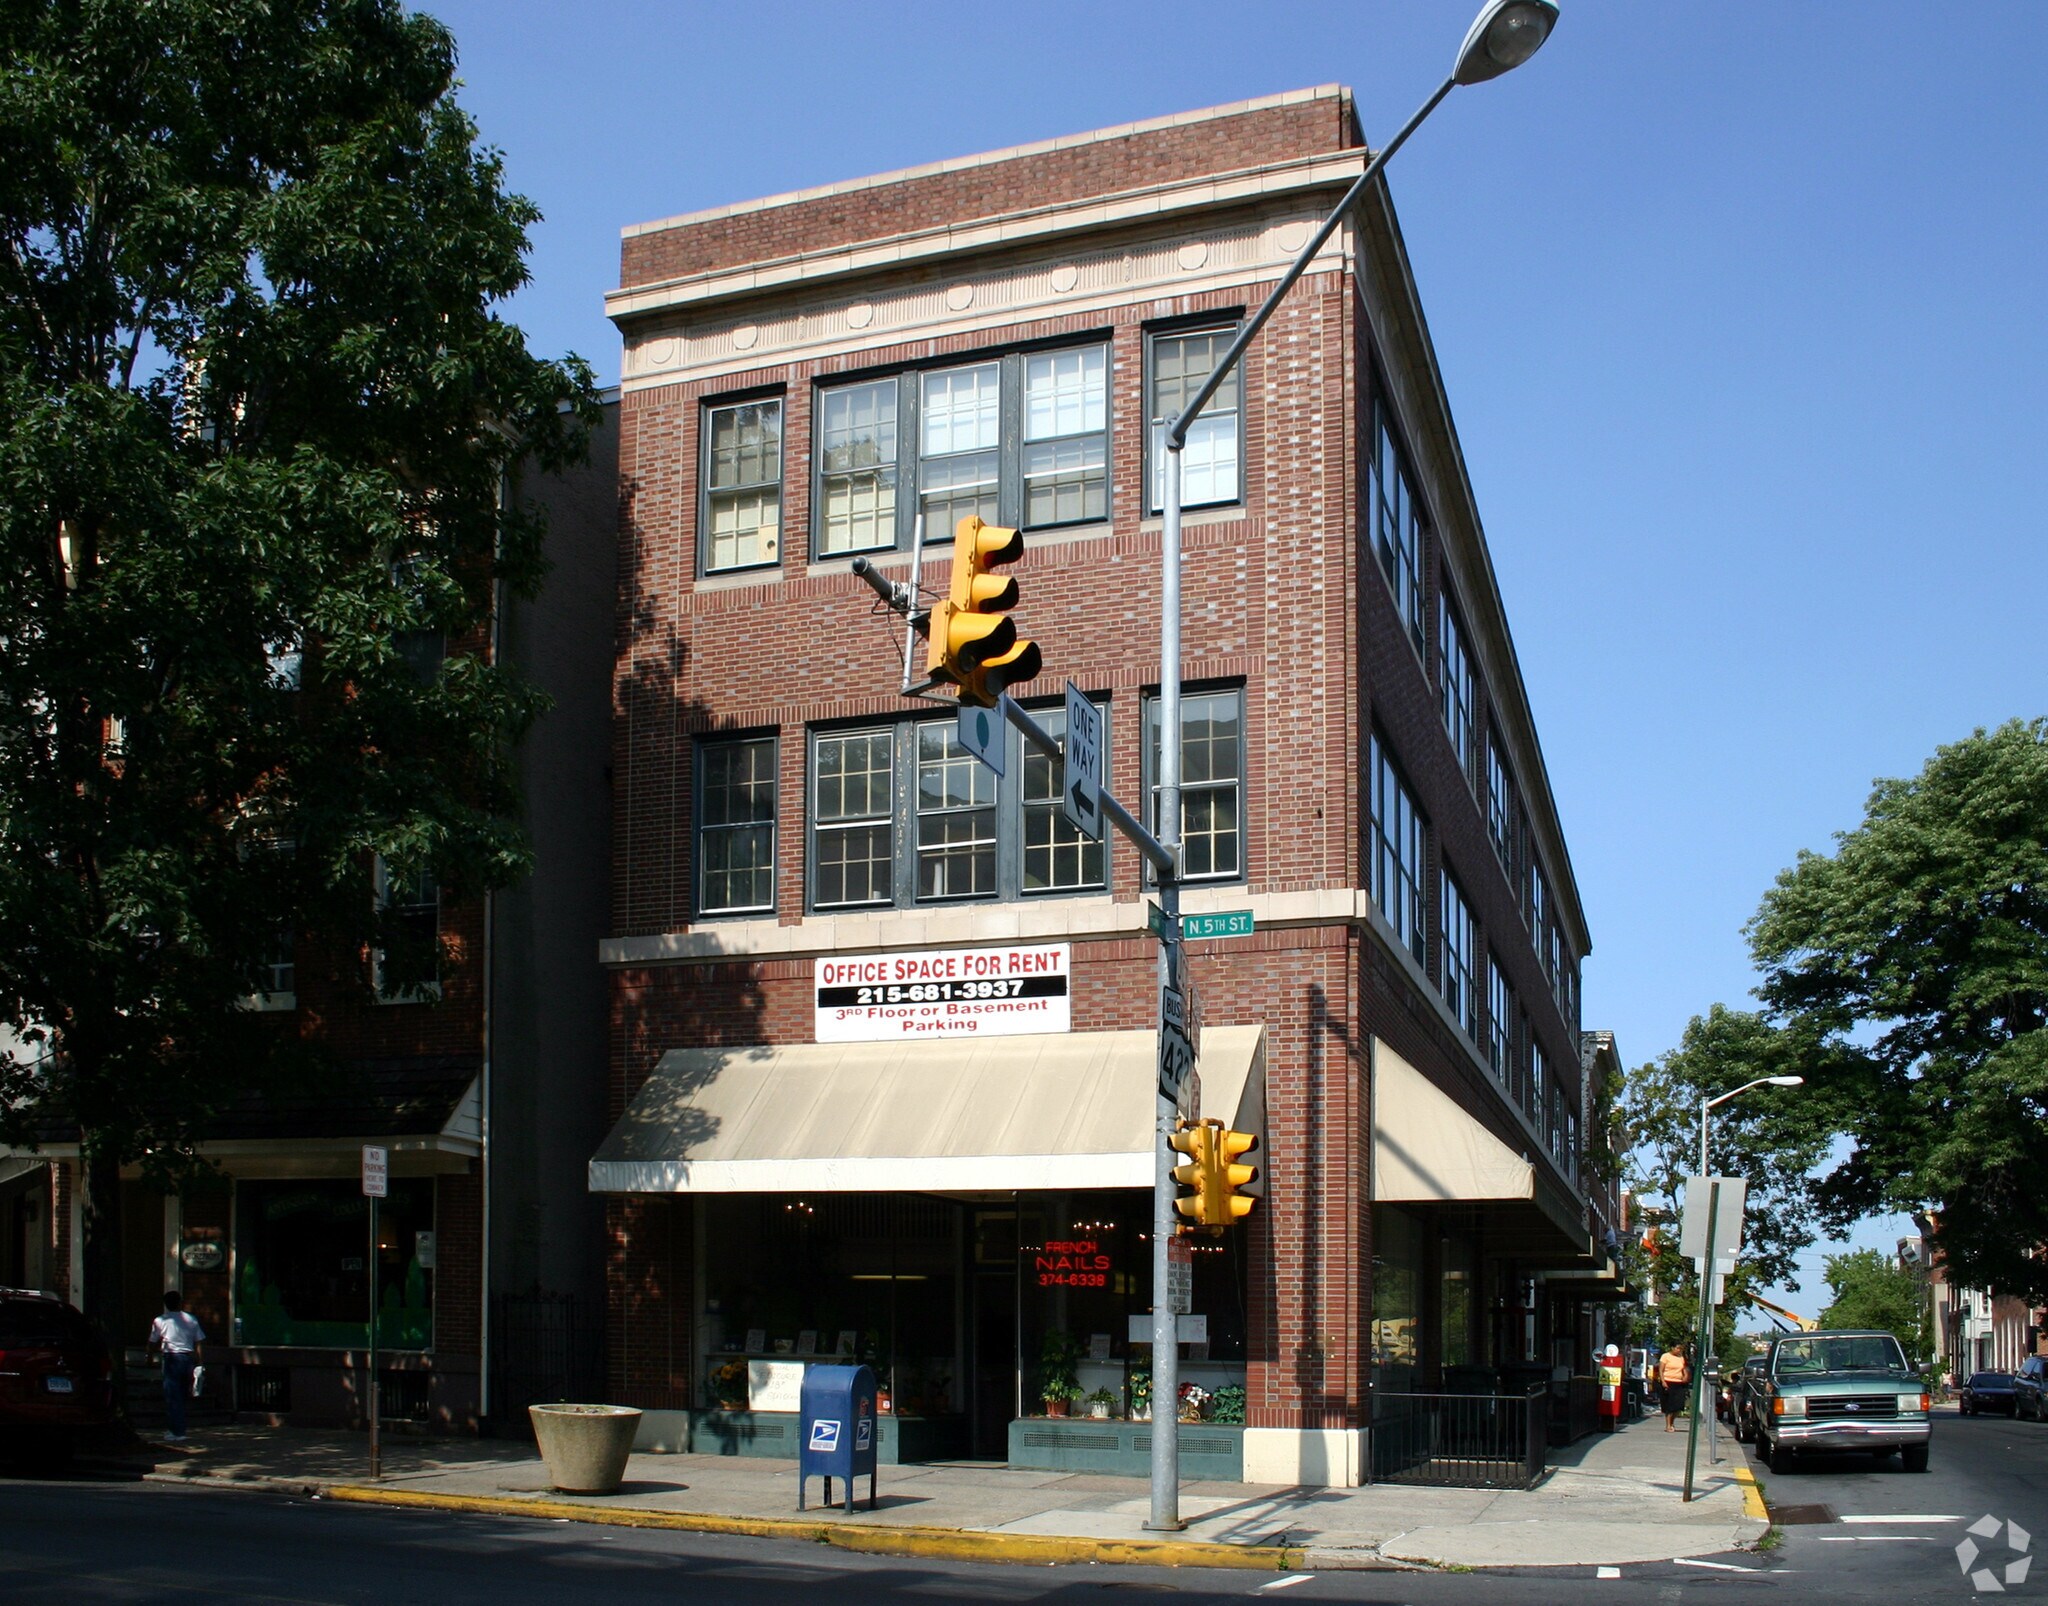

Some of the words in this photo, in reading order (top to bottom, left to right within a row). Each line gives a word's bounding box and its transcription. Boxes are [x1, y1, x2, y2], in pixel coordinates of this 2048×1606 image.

[1073, 701, 1094, 746] ONE
[1072, 735, 1095, 780] WAY
[1204, 918, 1225, 934] 5TH
[823, 962, 888, 984] OFFICE
[894, 957, 957, 981] SPACE
[963, 954, 1001, 976] FOR
[1008, 951, 1062, 974] RENT
[856, 979, 1025, 1004] 215-681-3937
[868, 1006, 915, 1019] Floor
[920, 1006, 940, 1017] or
[946, 999, 1049, 1015] Basement
[902, 1018, 979, 1032] Parking
[1045, 1241, 1097, 1254] FRENCH
[1036, 1255, 1110, 1271] NAILS
[1039, 1273, 1105, 1287] 374-6338
